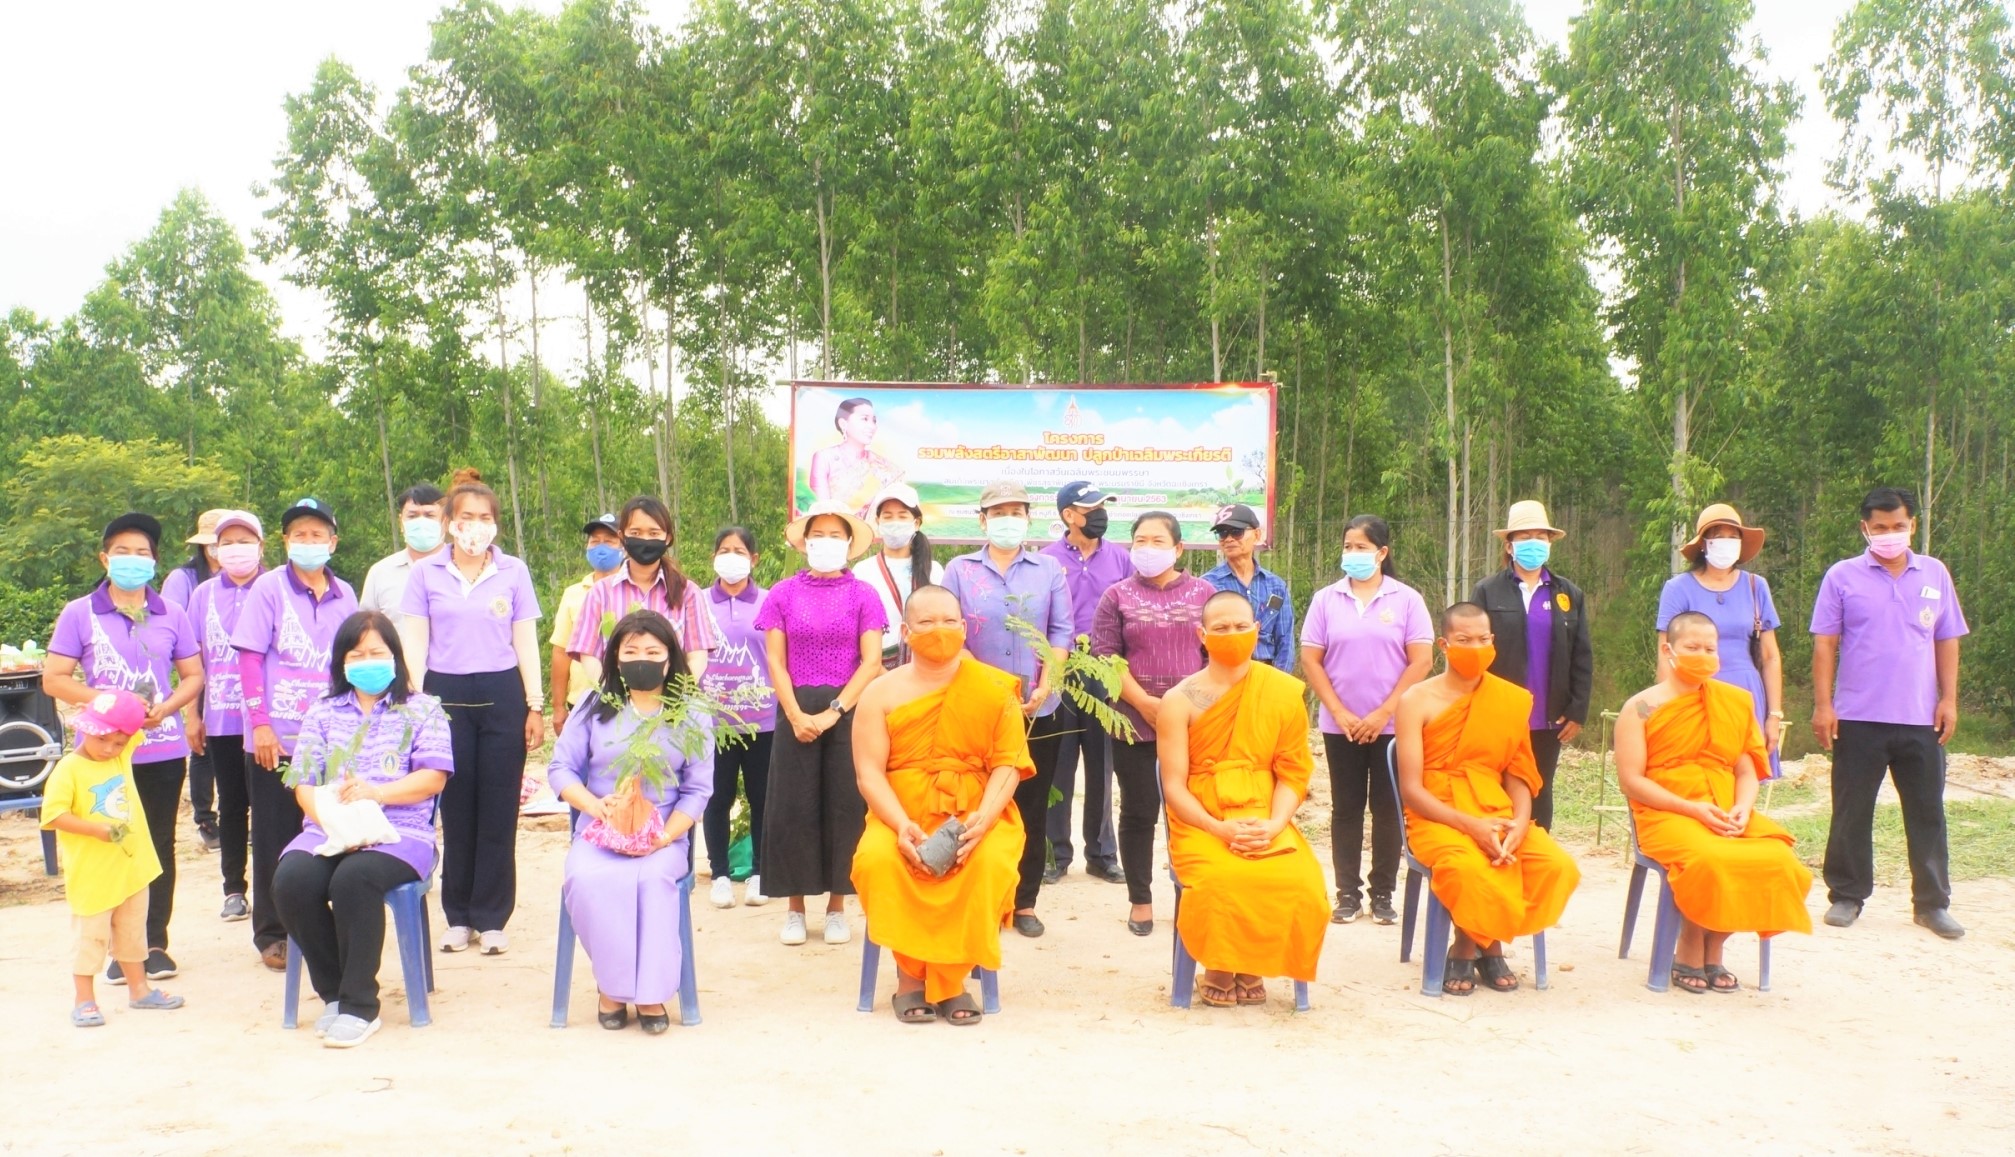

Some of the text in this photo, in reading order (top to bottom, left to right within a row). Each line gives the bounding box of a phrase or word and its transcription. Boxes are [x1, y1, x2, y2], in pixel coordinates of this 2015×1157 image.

[1042, 431, 1105, 446] โครงการ
[917, 445, 1232, 467] รวมพลังสตรีอาสาพัฒนา ปลูกป่าเฉลิมพระเกียรติ
[1145, 494, 1167, 503] 2563
